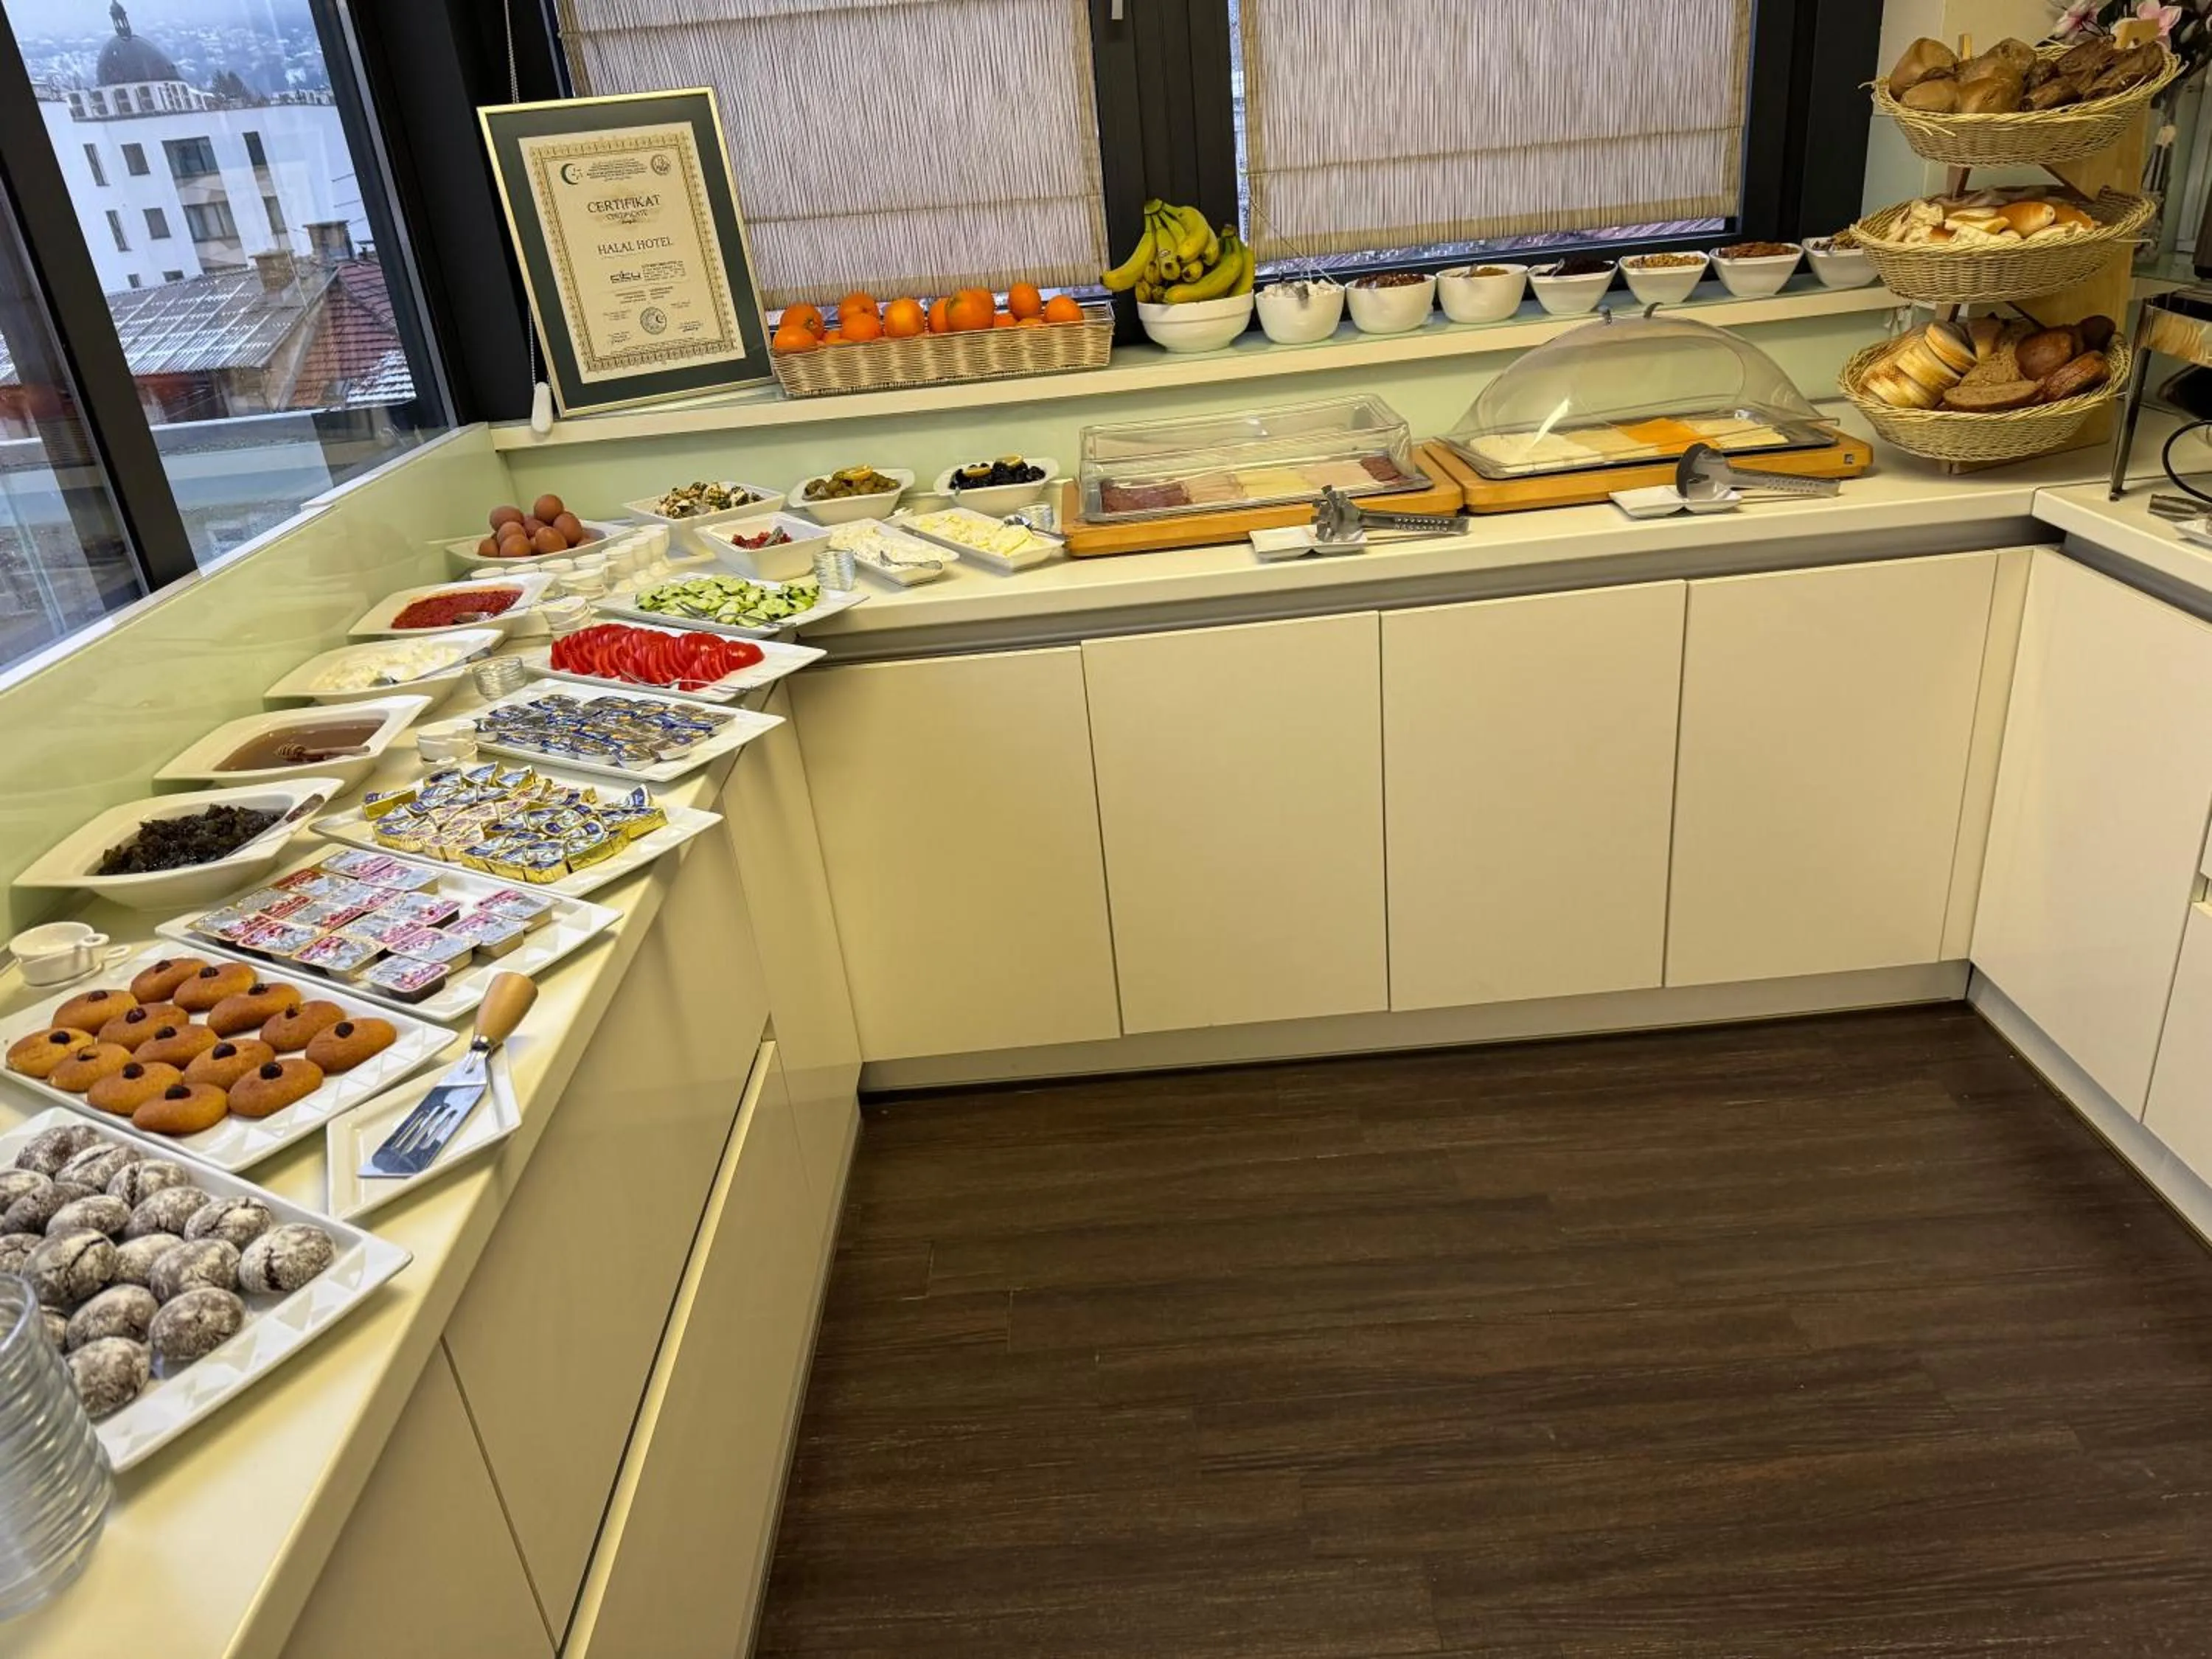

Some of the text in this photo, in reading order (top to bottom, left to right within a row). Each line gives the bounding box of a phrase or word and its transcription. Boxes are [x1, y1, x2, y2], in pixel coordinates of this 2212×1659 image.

[587, 194, 661, 213] CERTIFIKAT
[597, 237, 673, 255] HALAL HOTEL
